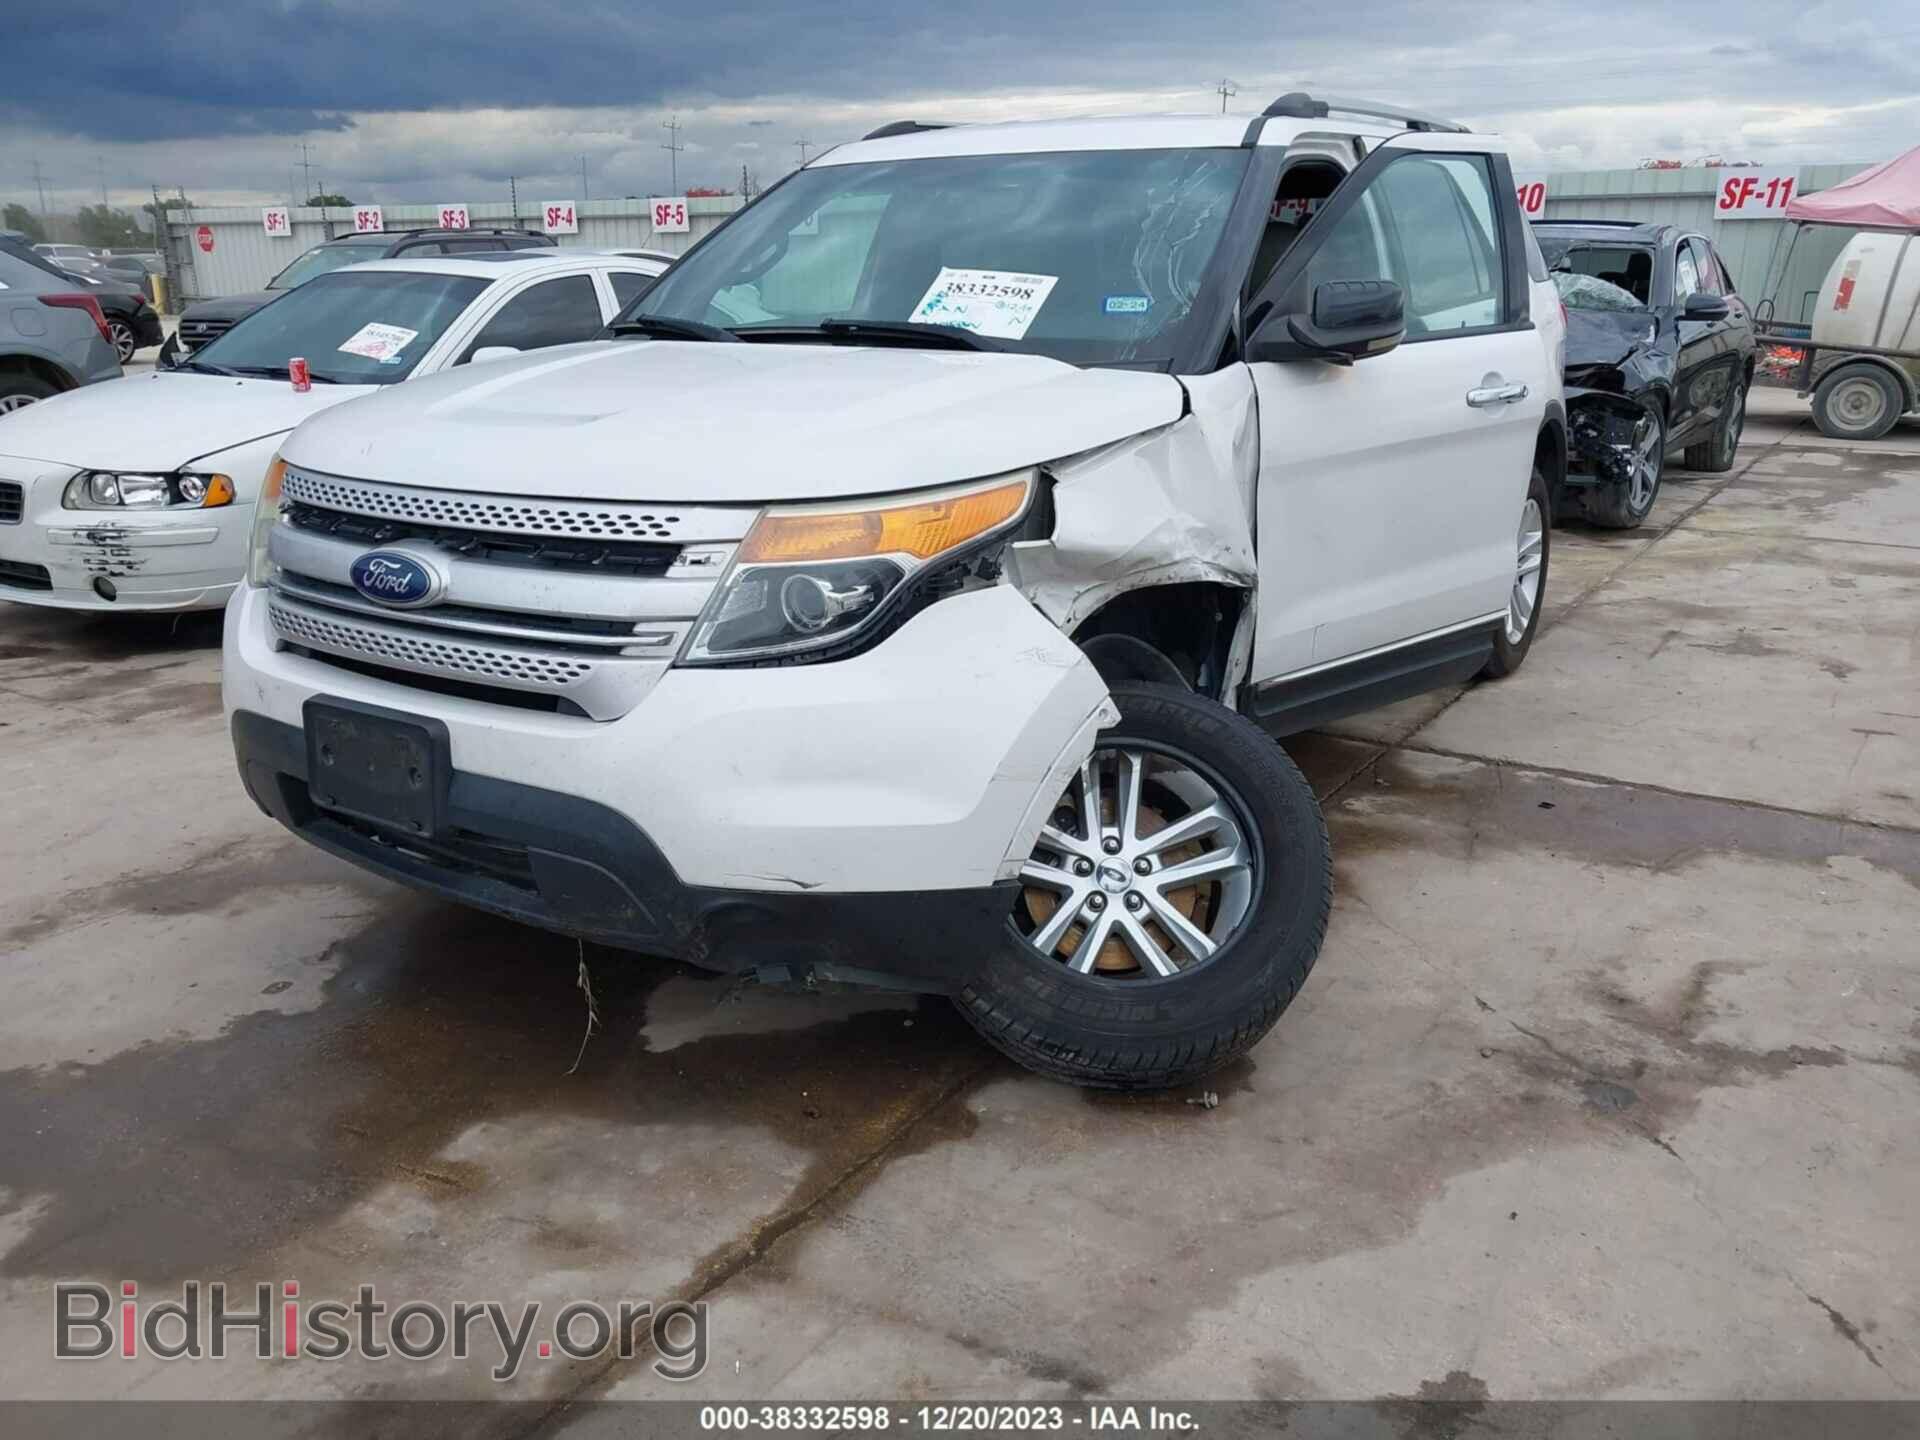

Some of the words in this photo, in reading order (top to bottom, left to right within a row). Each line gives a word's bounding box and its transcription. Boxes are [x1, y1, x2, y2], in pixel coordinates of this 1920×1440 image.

[1719, 177, 1794, 209] SF-11
[266, 212, 286, 231] SF-1
[357, 211, 380, 231] SF-2
[442, 210, 466, 229] SF-3
[547, 207, 573, 227] SF-4
[655, 204, 684, 226] SF-5
[946, 282, 1035, 300] 38332598
[363, 558, 413, 594] Ford
